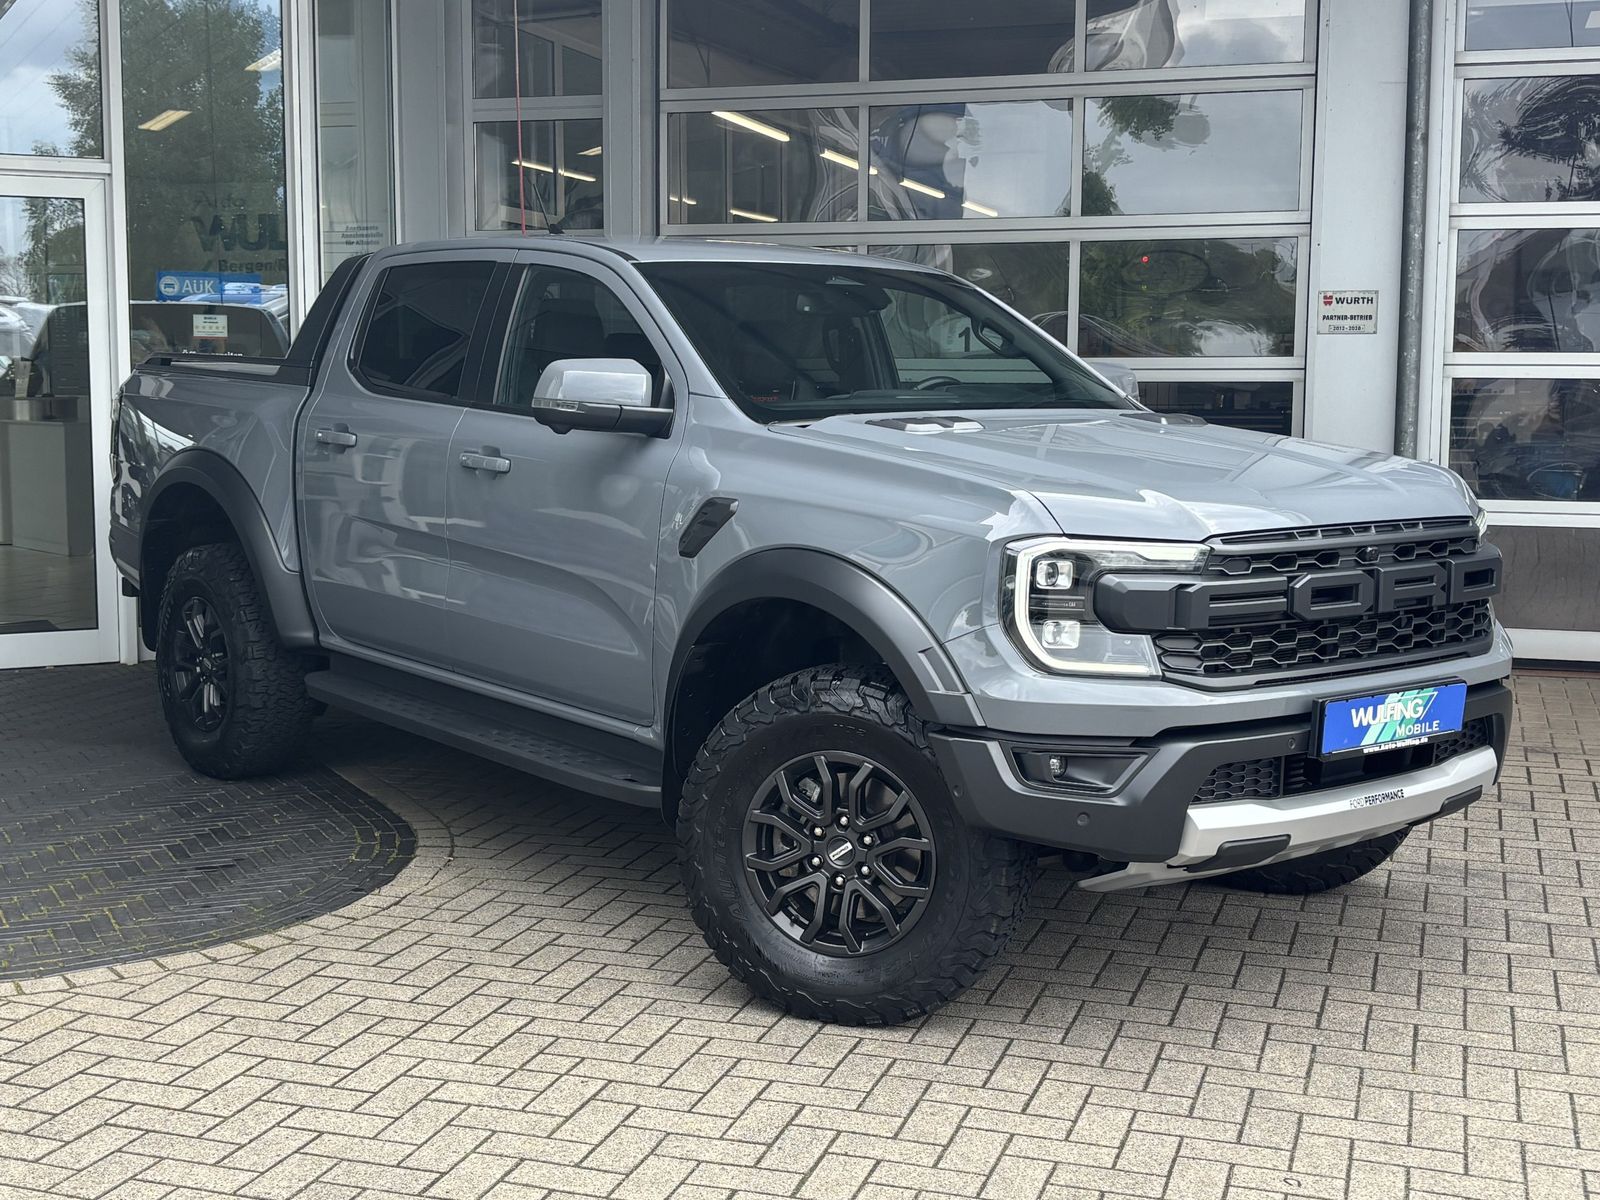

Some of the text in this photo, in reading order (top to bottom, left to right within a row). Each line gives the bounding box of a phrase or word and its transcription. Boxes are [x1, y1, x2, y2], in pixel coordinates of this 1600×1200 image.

[1172, 544, 1502, 632] FORD
[1395, 720, 1440, 738] MOBILE
[1350, 788, 1404, 809] FORD PERFORMANCE
